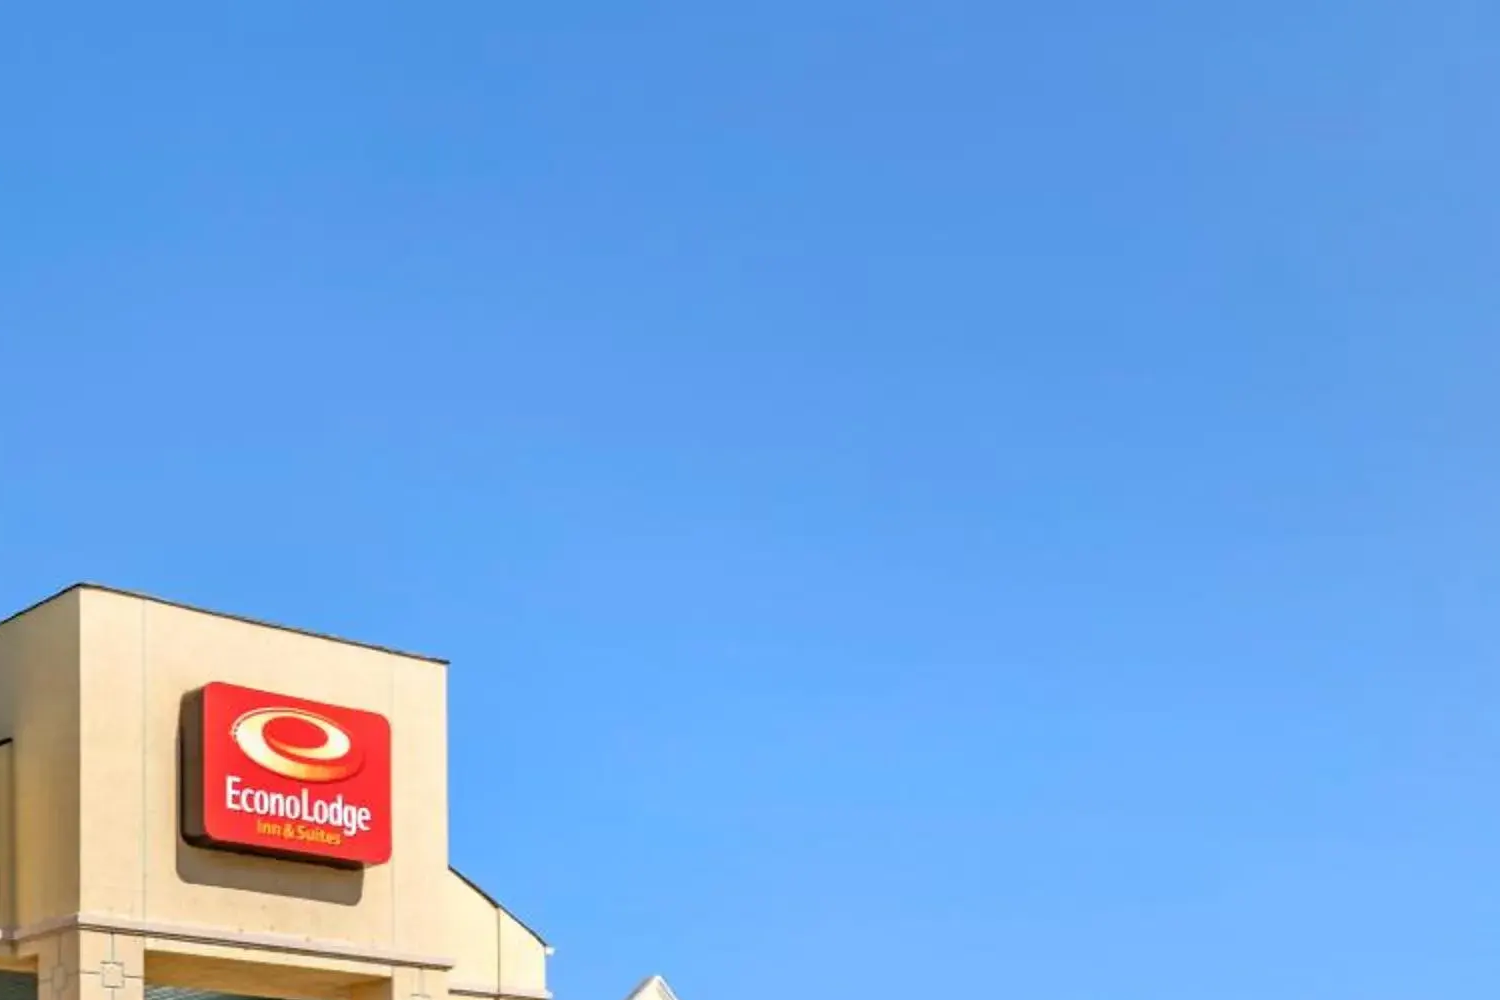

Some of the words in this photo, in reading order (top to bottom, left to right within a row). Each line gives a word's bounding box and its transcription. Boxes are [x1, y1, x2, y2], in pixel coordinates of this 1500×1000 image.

[225, 775, 371, 836] EconoLodge
[257, 820, 281, 837] Inn
[283, 823, 295, 839] &
[298, 824, 341, 845] Suites
